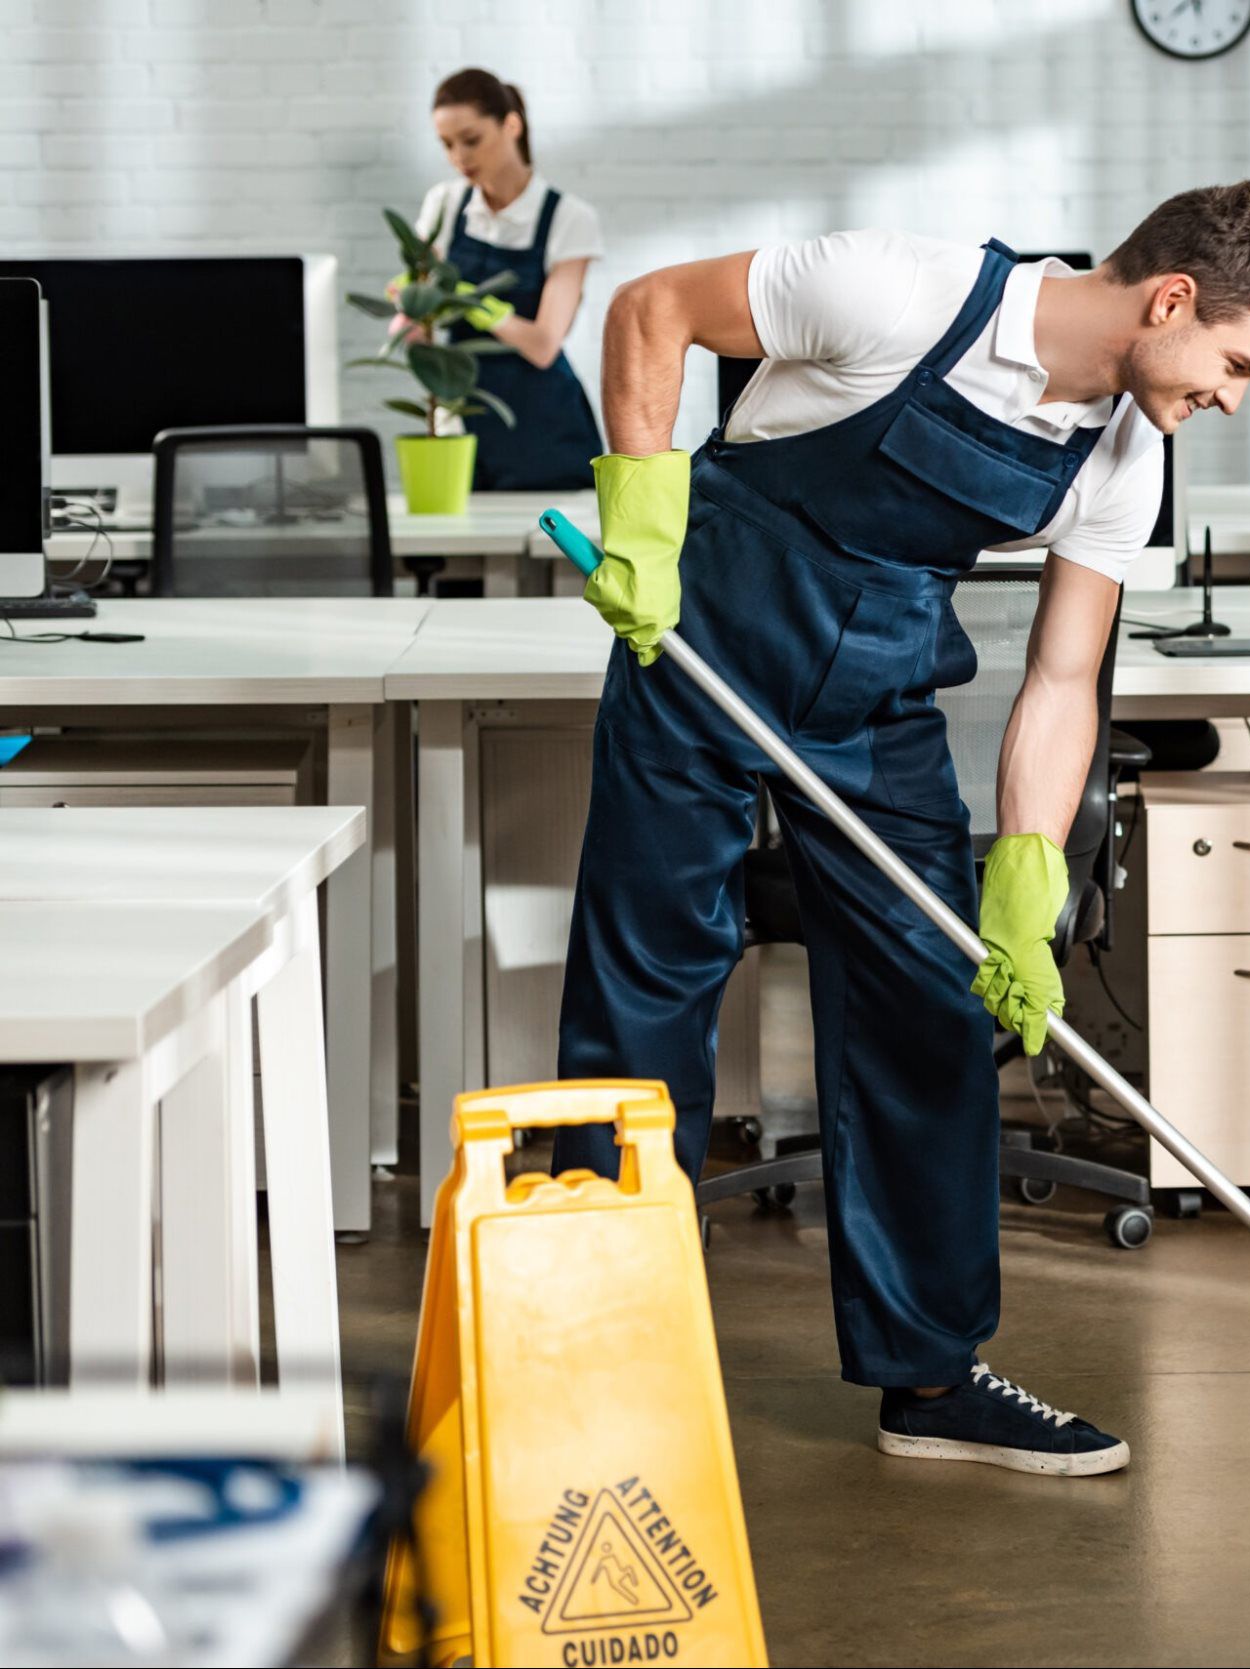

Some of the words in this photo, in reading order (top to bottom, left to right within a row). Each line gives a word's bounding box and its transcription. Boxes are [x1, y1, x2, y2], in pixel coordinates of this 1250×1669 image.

[518, 1489, 590, 1614] ACHTUNG
[615, 1476, 718, 1608] ATTENTION
[562, 1631, 678, 1667] CUIDADO
